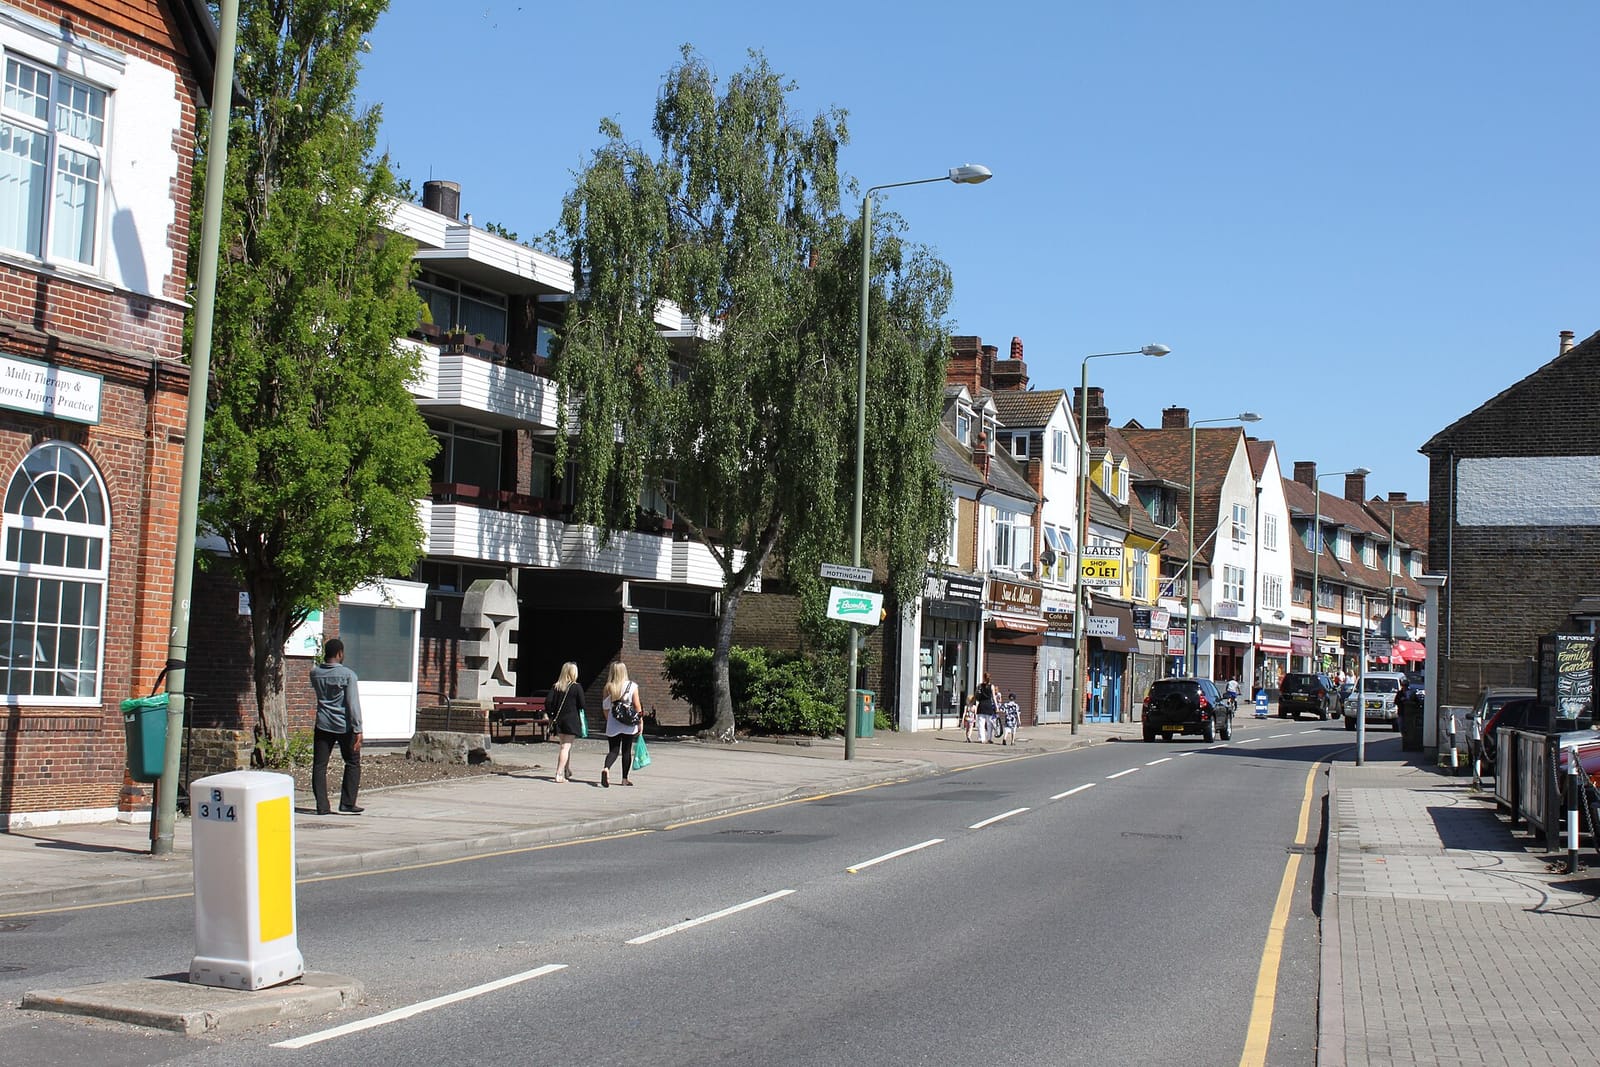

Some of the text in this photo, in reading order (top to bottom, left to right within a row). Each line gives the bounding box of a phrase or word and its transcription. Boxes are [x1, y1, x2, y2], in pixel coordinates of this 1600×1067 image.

[5, 366, 82, 393] Multi Therapy &
[0, 386, 94, 412] ports Injury Practice
[1082, 547, 1121, 556] LAKES
[826, 570, 867, 581] MOTTINGHAM
[1082, 567, 1117, 577] TO LET
[1557, 648, 1591, 664] Family
[1559, 660, 1594, 673] Garden
